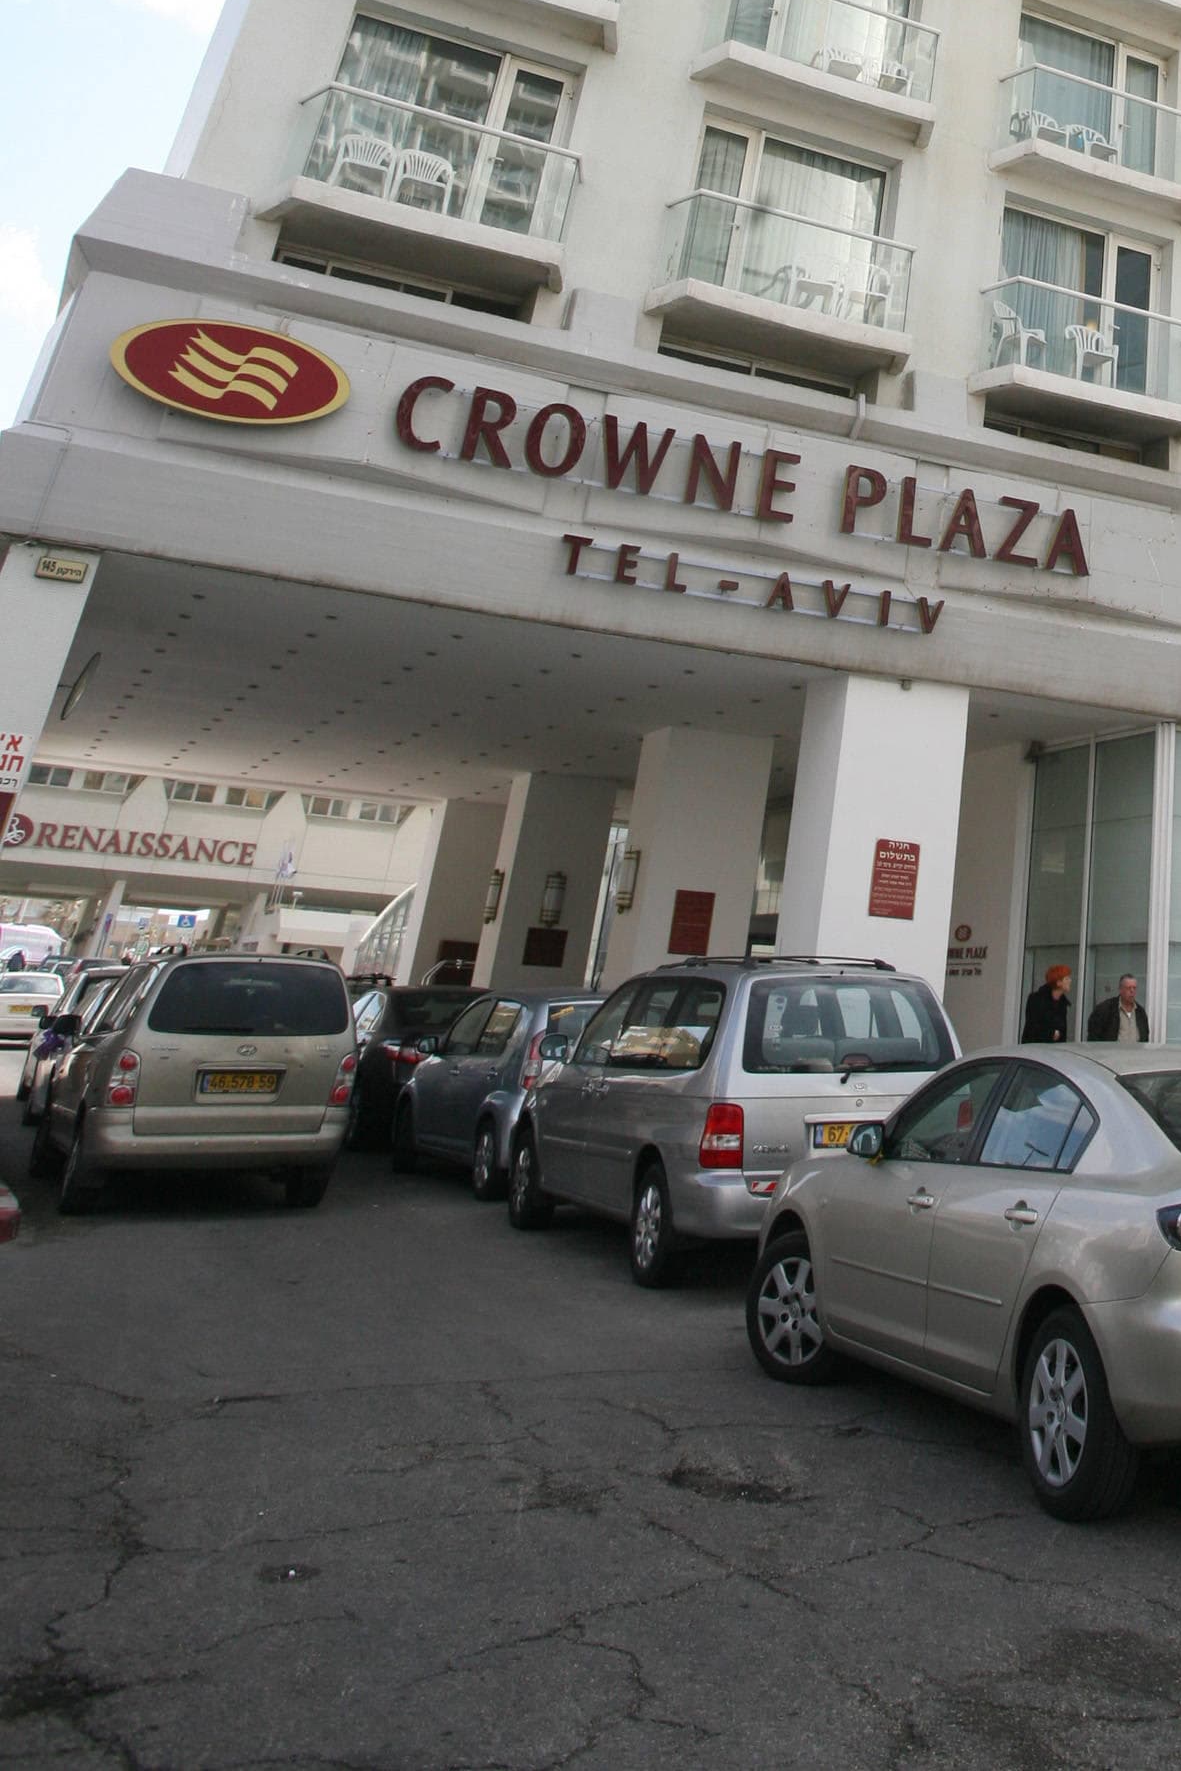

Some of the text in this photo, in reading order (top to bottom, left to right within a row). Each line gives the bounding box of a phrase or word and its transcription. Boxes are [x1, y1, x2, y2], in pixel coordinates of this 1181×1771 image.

[396, 376, 1089, 576] CROWNE PLAZA
[34, 822, 257, 867] RENAISSANCE
[880, 851, 916, 861] בתשלום
[889, 841, 910, 850] חניה
